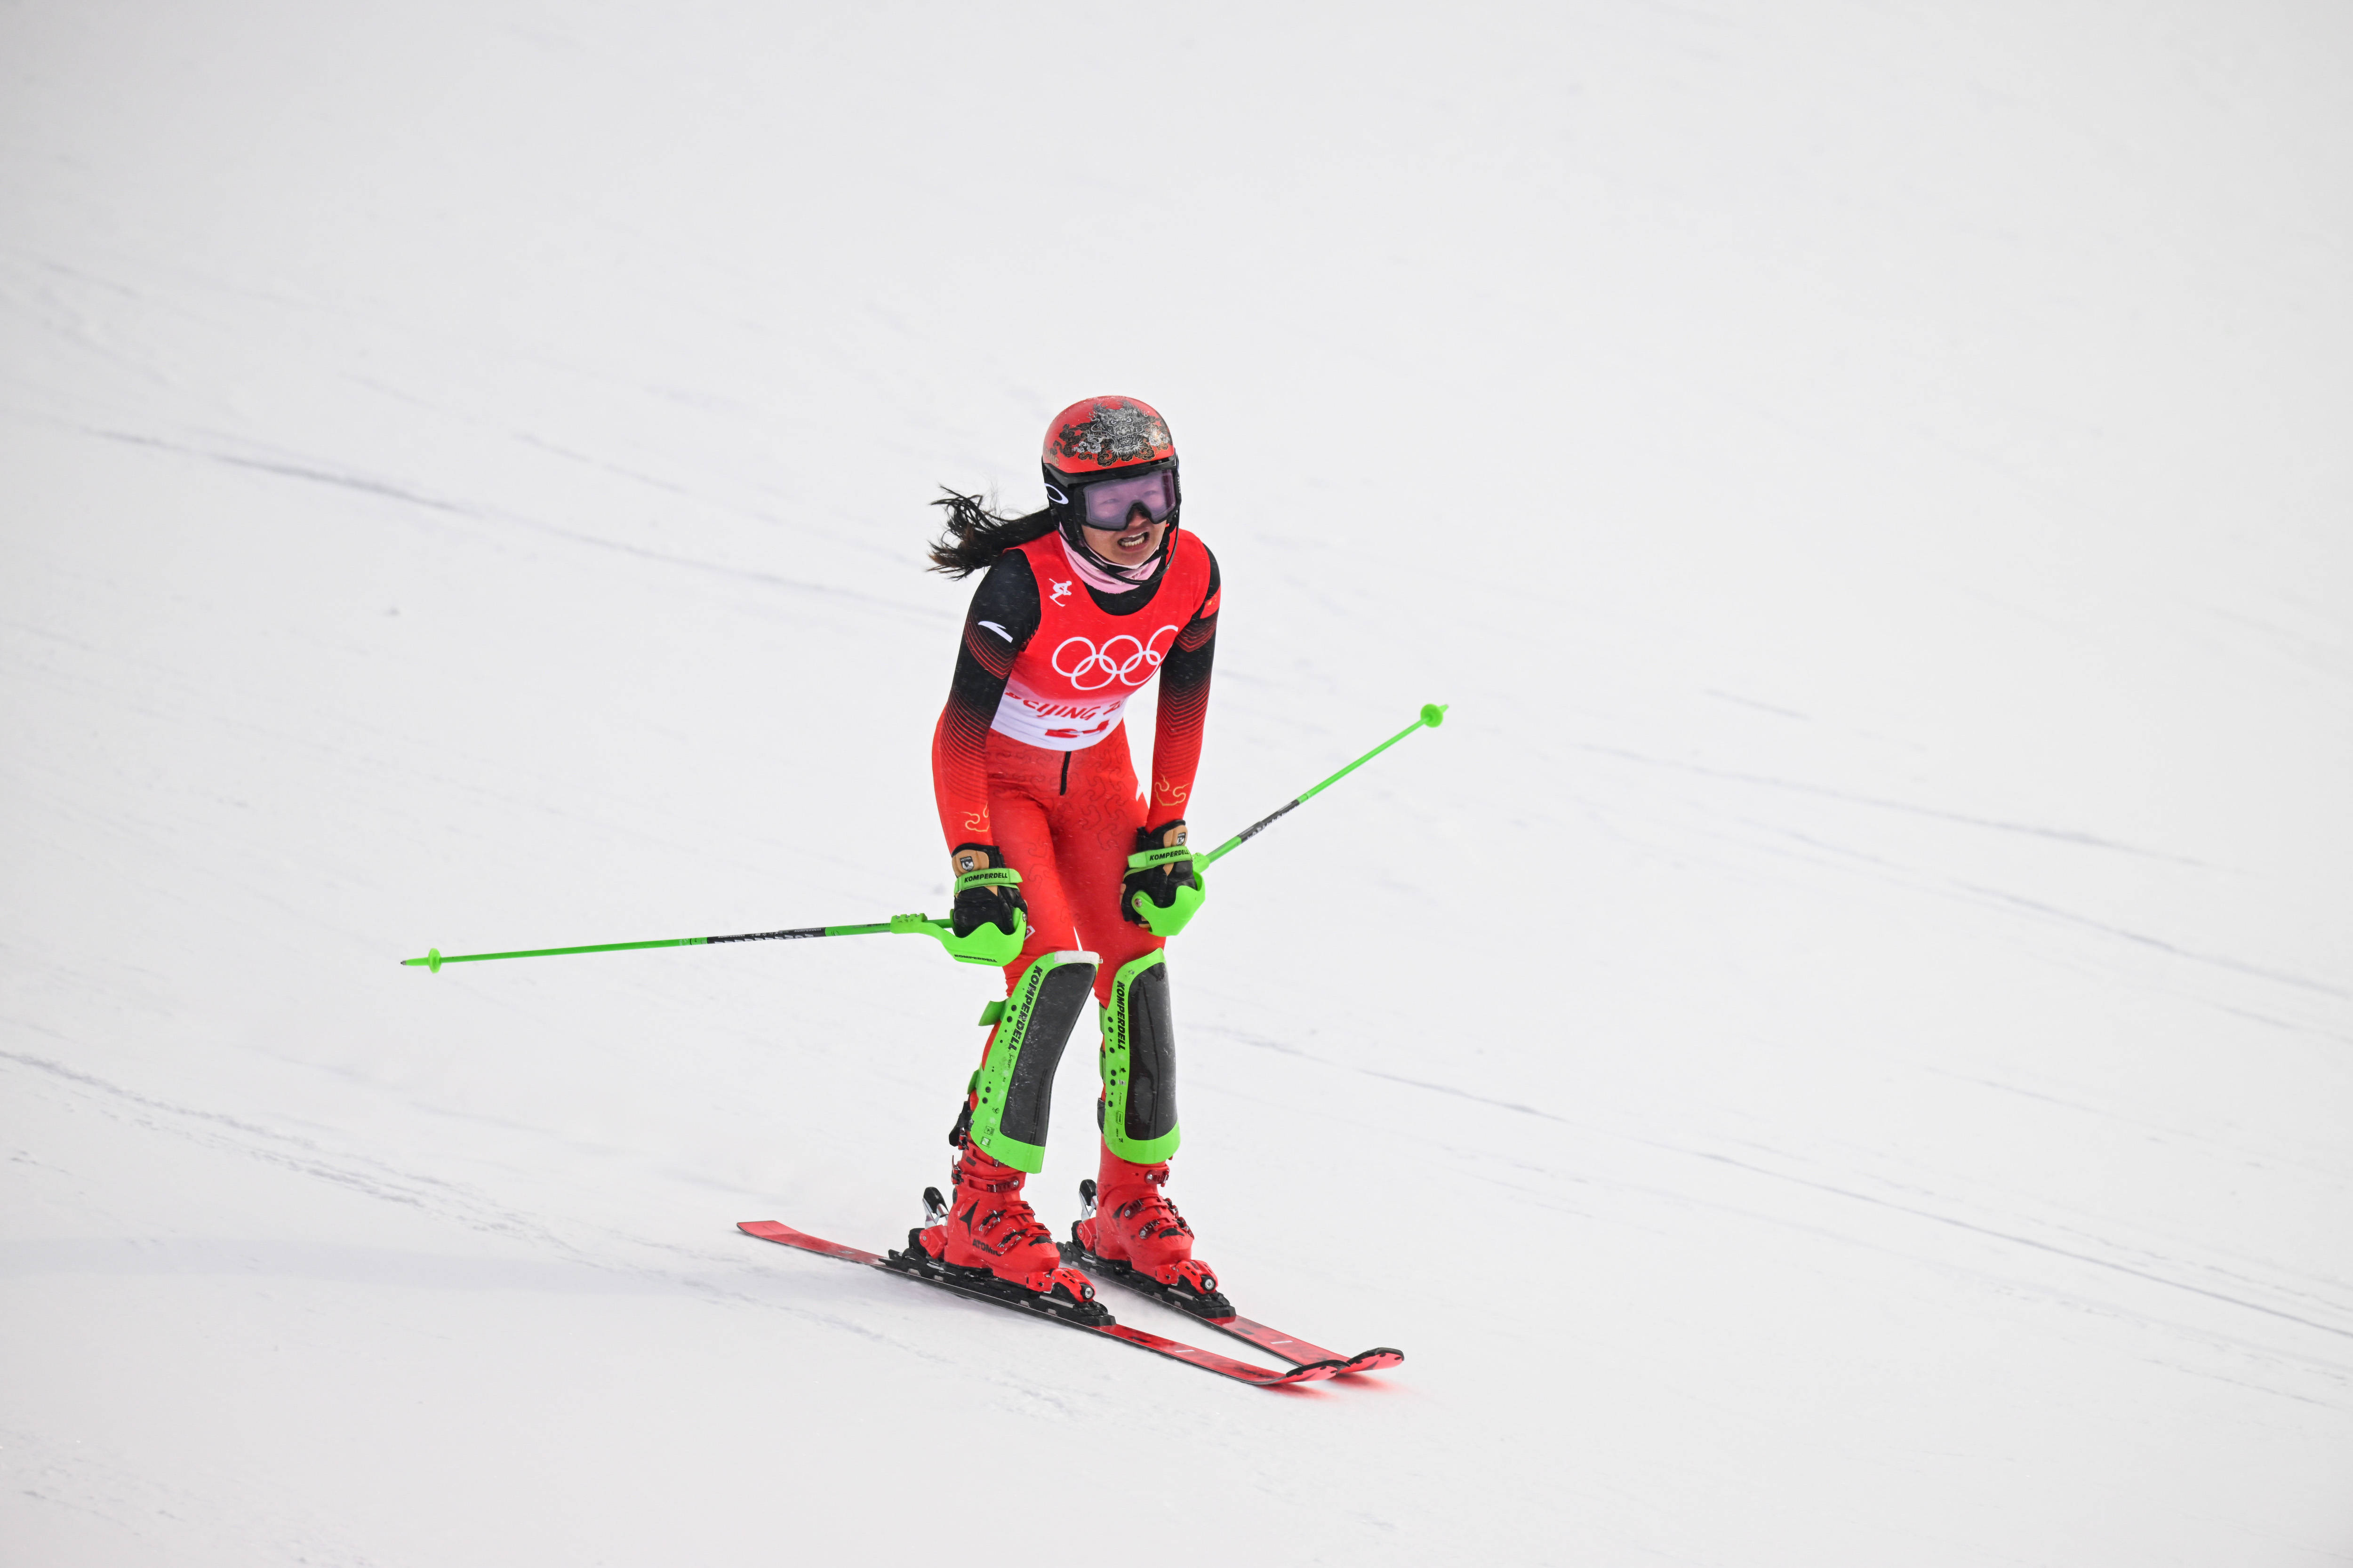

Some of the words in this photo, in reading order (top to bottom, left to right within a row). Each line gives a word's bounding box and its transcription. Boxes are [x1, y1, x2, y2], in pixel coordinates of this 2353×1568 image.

[1149, 849, 1189, 861] KOMPERDELL
[964, 872, 1008, 883] KOMPERDELL
[954, 954, 998, 963] KOMPERDELL
[1008, 965, 1043, 1051] KOMPERDELL
[1117, 980, 1126, 1050] KOMPERDELL
